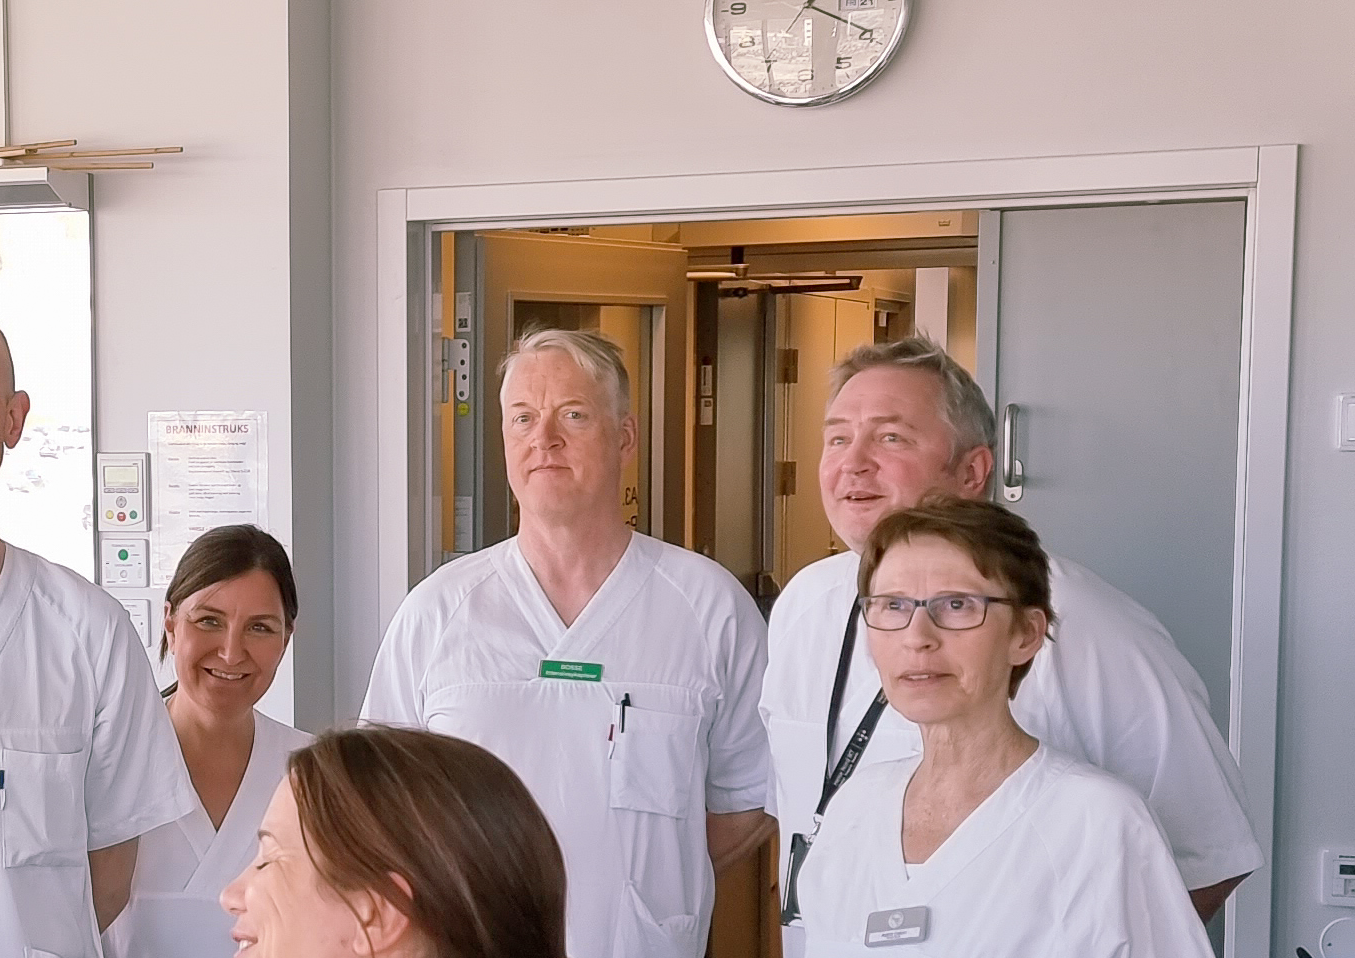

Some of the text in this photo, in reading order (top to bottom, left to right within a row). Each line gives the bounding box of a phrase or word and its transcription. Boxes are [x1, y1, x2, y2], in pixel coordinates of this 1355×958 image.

[730, 2, 747, 15] 9
[835, 56, 853, 69] 5
[165, 424, 250, 435] BRANNINSTRUKS
